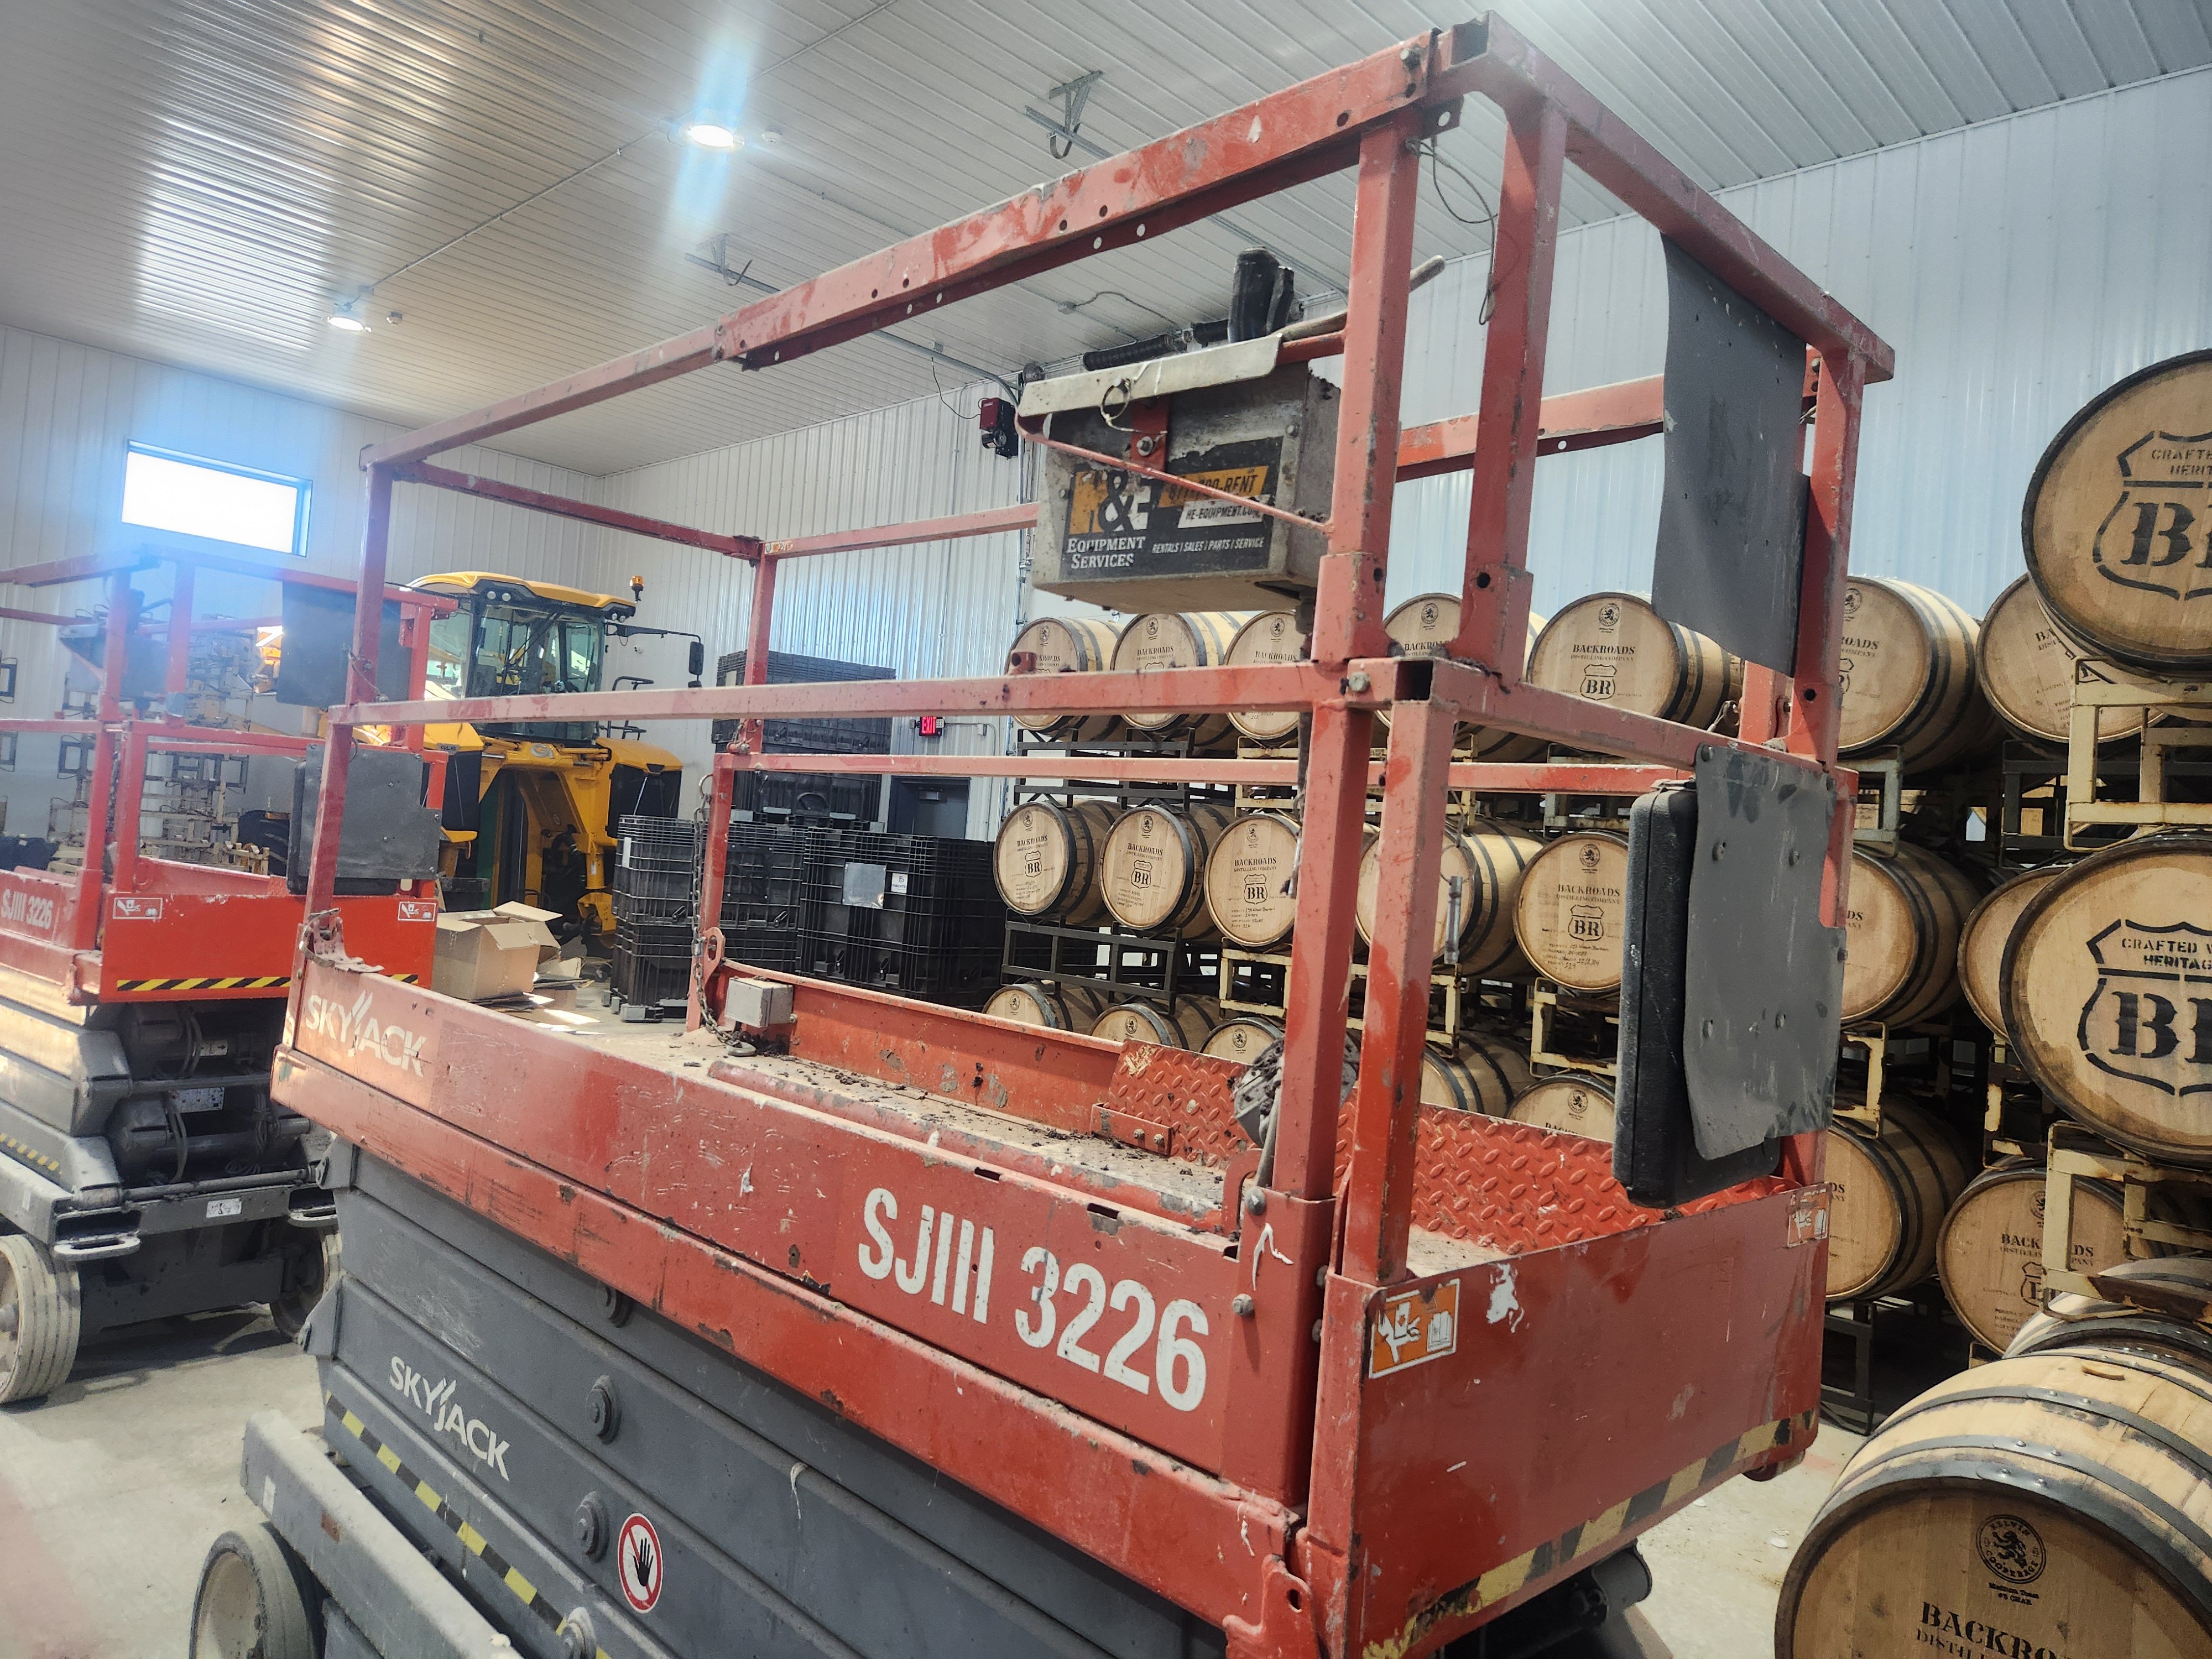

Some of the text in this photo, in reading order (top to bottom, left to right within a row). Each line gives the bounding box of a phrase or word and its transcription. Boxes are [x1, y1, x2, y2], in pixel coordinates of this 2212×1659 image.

[2152, 449, 2212, 460] CRAFTE
[2171, 465, 2212, 475] HERIT
[2120, 502, 2212, 568] B
[1066, 536, 1146, 554] EQUIPMENT
[1183, 540, 1205, 552] SALES
[1207, 539, 1230, 551] PARTS
[1234, 536, 1265, 549] SERVICE
[1071, 553, 1134, 569] SERVICES
[1137, 646, 1174, 656] BACKROADS
[1405, 641, 1443, 651] BACKRO
[1573, 644, 1636, 655] BACKROADS
[1255, 650, 1297, 661] BACKROADS
[1585, 680, 1611, 695] BR
[922, 716, 936, 734] EXIT
[1016, 835, 1048, 847] BACKROADS
[1127, 843, 1164, 856] BACKROADS
[1027, 862, 1040, 874] BR
[1234, 857, 1277, 867] BACKROADS
[1134, 871, 1149, 885] BR
[1247, 887, 1266, 900] BR
[1558, 884, 1620, 896] BACKROADS
[26, 895, 54, 930] 3226
[1574, 920, 1599, 936] BR
[2122, 938, 2197, 953] CRAFTED
[2143, 955, 2212, 970] HERITAG
[306, 989, 427, 1077] SKYJACK
[859, 1187, 1209, 1412] SJIII 3226
[390, 1355, 510, 1481] SKYJACK
[1921, 1601, 2058, 1659] BACKRO
